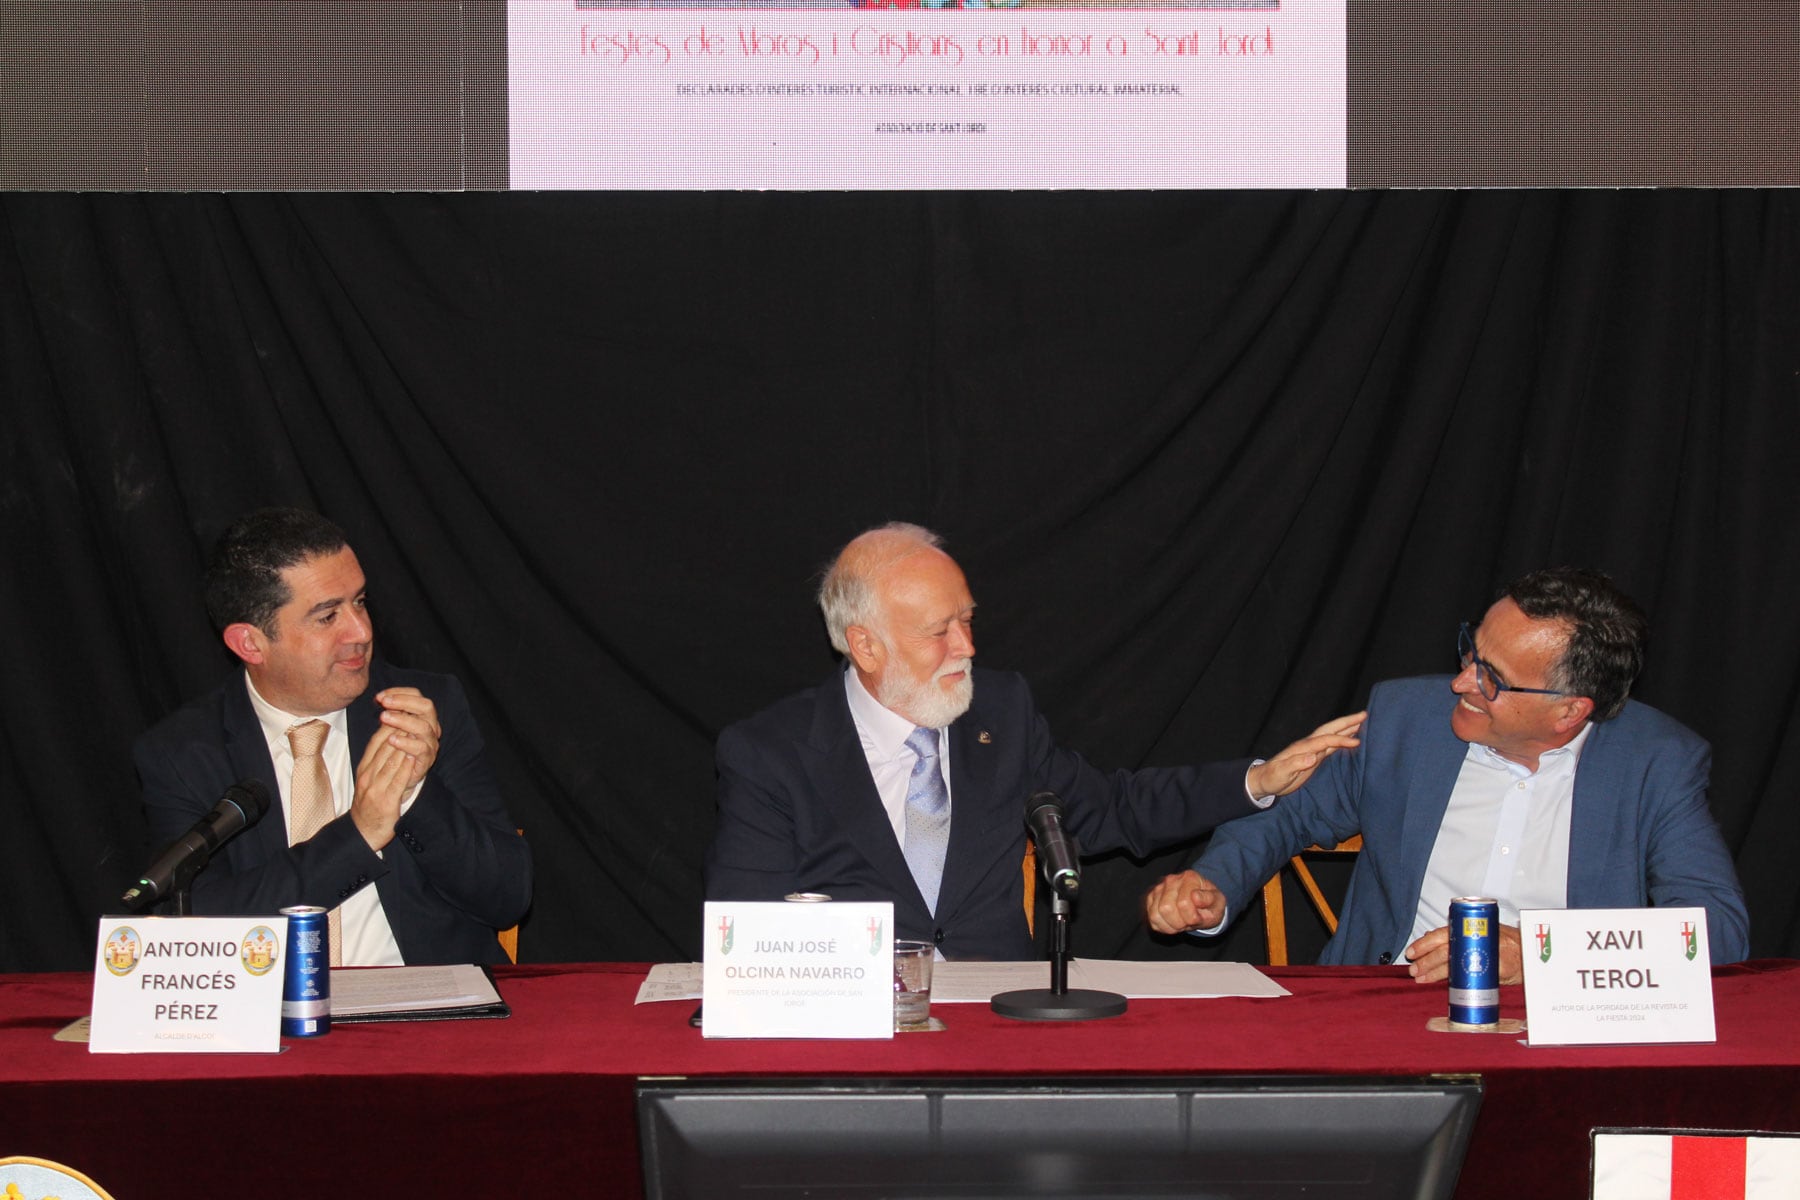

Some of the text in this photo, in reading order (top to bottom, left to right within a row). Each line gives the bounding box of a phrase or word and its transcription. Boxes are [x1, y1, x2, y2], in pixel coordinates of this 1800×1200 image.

[579, 25, 672, 66] Festes
[683, 25, 725, 57] de
[737, 25, 821, 66] Moros
[850, 26, 965, 66] Cristians
[976, 34, 1009, 57] en
[1020, 26, 1093, 57] honor
[1105, 35, 1128, 57] a
[1143, 25, 1199, 57] Sant
[143, 941, 238, 957] ANTONIO
[753, 938, 837, 954] JUAN JOSÉ
[1586, 930, 1644, 951] XAVI
[140, 970, 237, 990] FRANCÉS
[725, 966, 865, 979] OLCINA NAVARRO
[1576, 968, 1660, 989] TEROL
[154, 1001, 219, 1020] PÉREZ
[1551, 1003, 1575, 1012] AUTOR
[1576, 1003, 1585, 1012] DE
[1587, 1003, 1596, 1011] LA
[1631, 1003, 1641, 1011] DE
[1650, 1002, 1677, 1010] REVISTA
[1678, 1002, 1689, 1010] DE
[1596, 1014, 1606, 1022] LA
[1606, 1014, 1628, 1022] FIESTA
